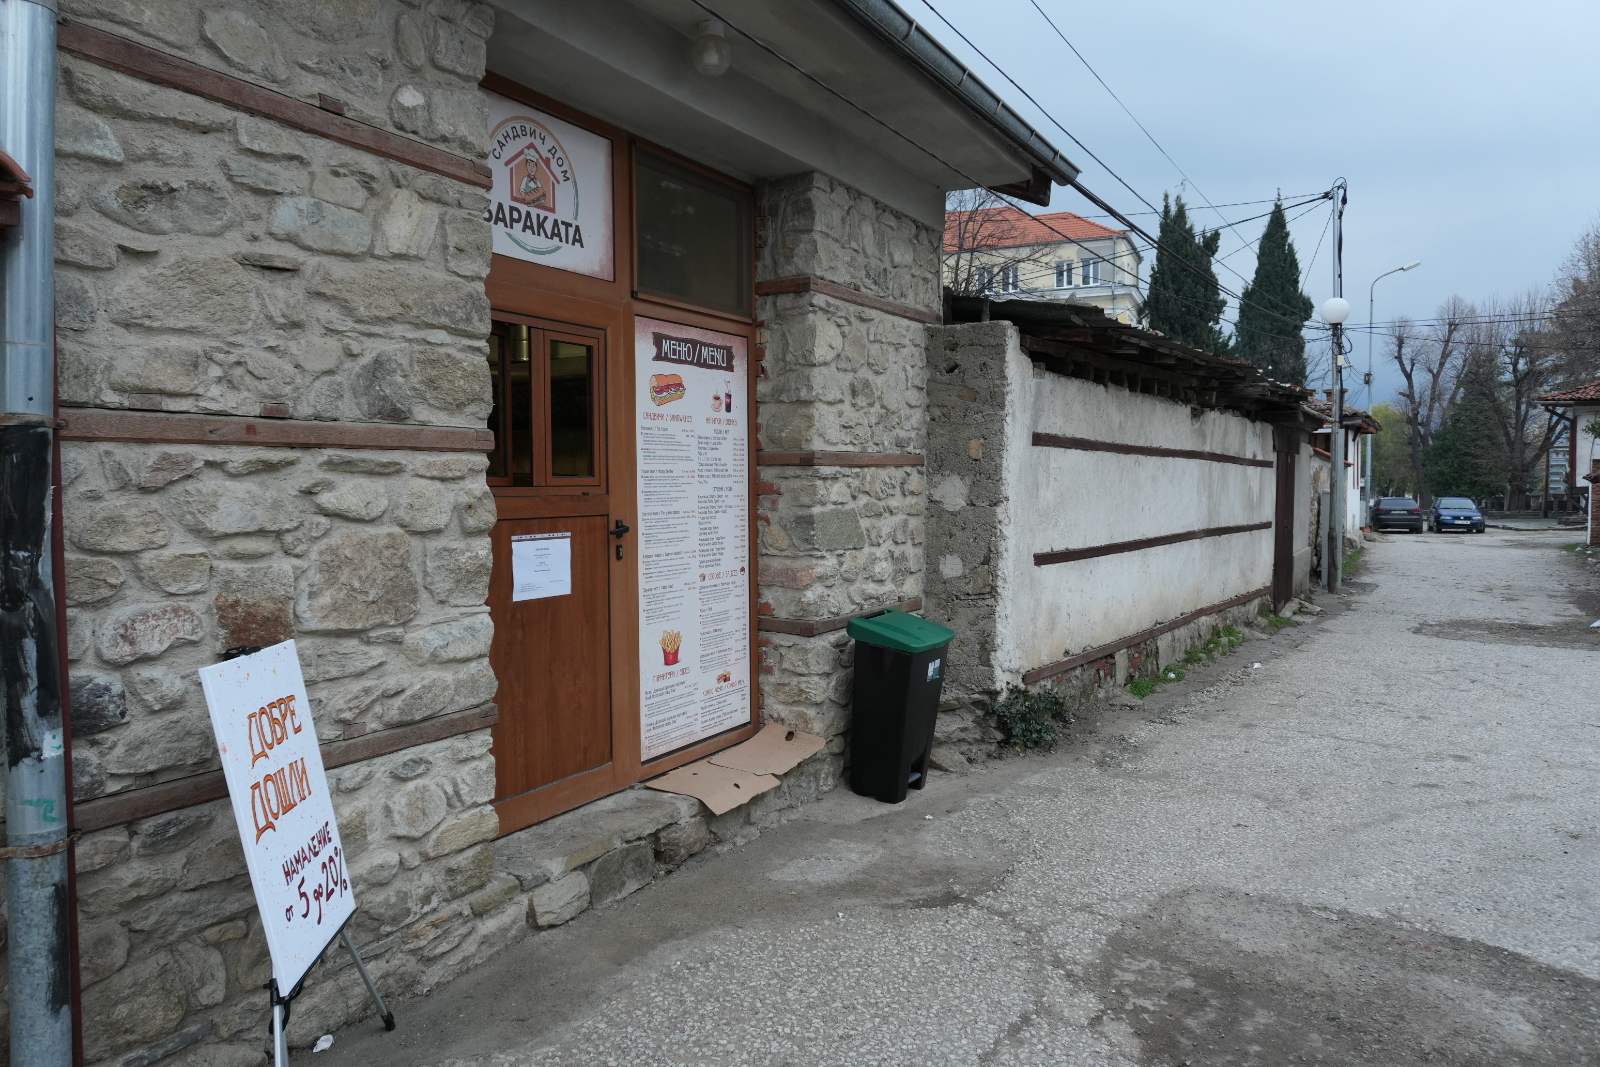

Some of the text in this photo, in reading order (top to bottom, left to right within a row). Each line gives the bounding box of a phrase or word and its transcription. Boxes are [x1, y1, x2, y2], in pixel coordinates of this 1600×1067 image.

[492, 124, 571, 183] САНДВИЧ ДОМ
[661, 338, 693, 361] МЕНЮ
[701, 345, 727, 367] MENU
[247, 694, 303, 770] ДОБРЕ
[250, 757, 312, 846] ДОШЛИ
[281, 820, 332, 886] НАМАЛЕНИЕ
[297, 875, 310, 919] 5
[321, 846, 348, 902] 20%
